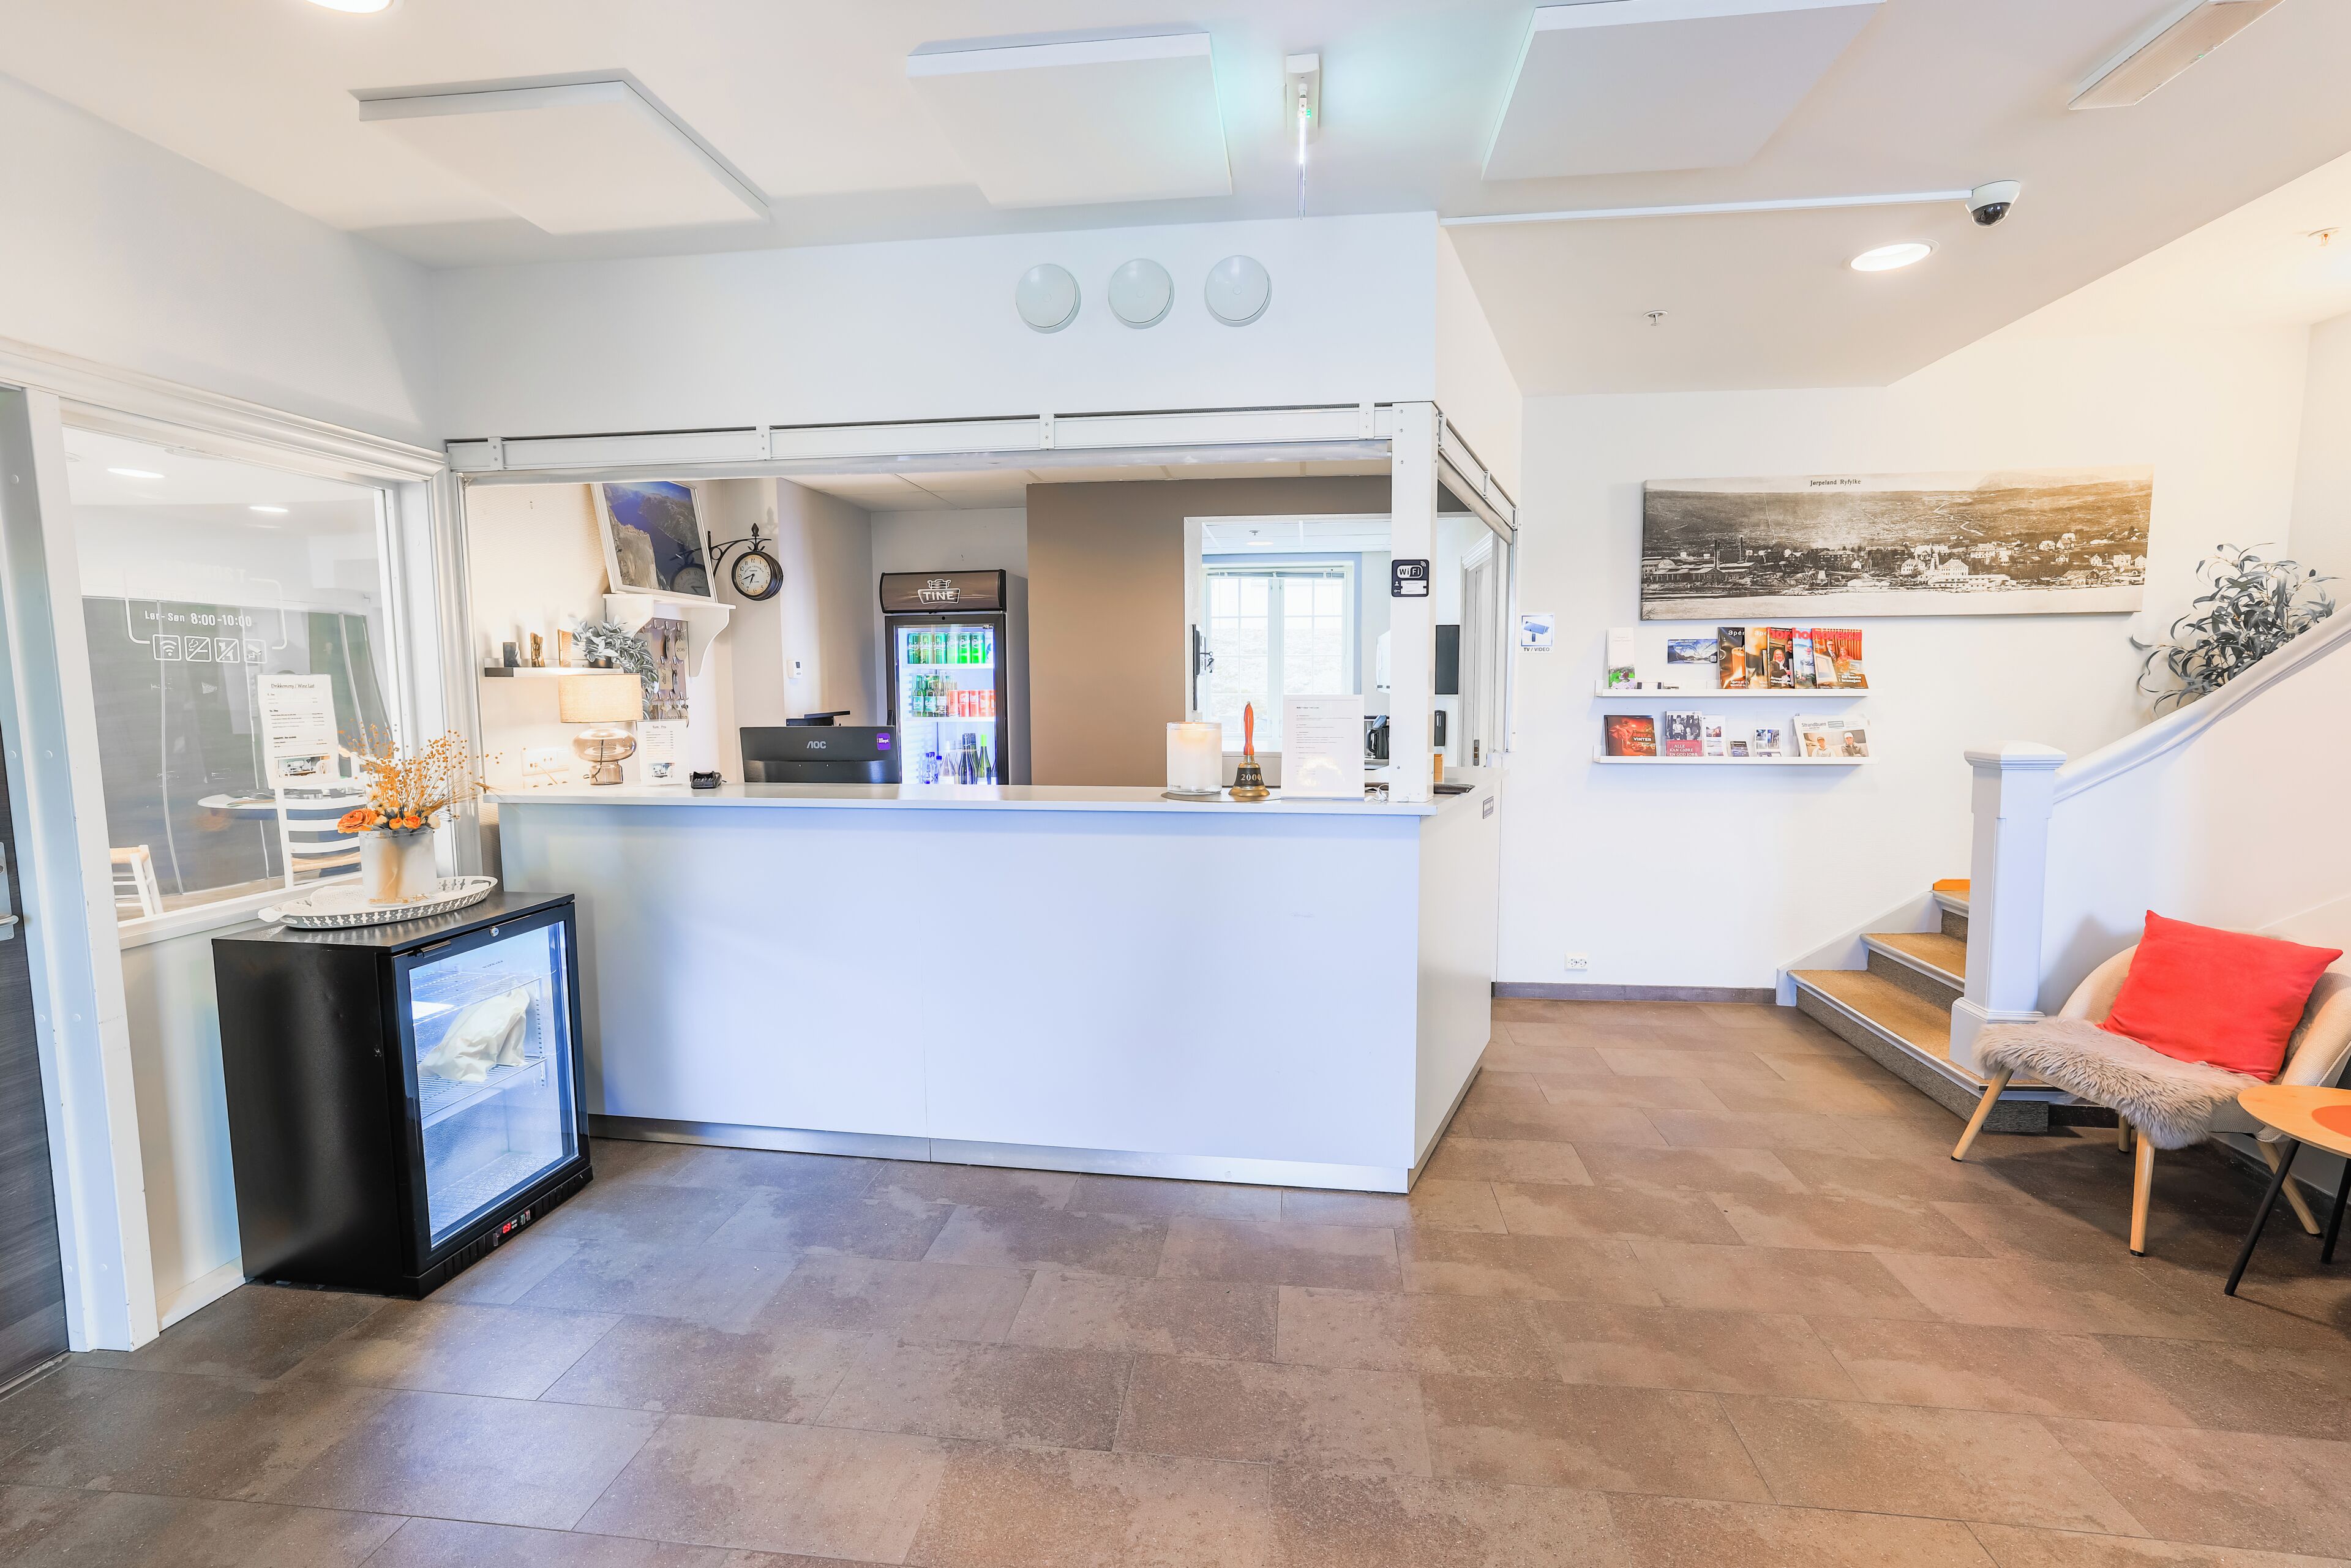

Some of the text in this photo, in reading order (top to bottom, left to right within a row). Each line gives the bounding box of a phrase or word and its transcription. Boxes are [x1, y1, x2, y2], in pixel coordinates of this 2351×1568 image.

[923, 591, 955, 601] TINE
[168, 612, 186, 623] Søn
[1770, 630, 1792, 639] hor
[1793, 628, 1812, 640] ho
